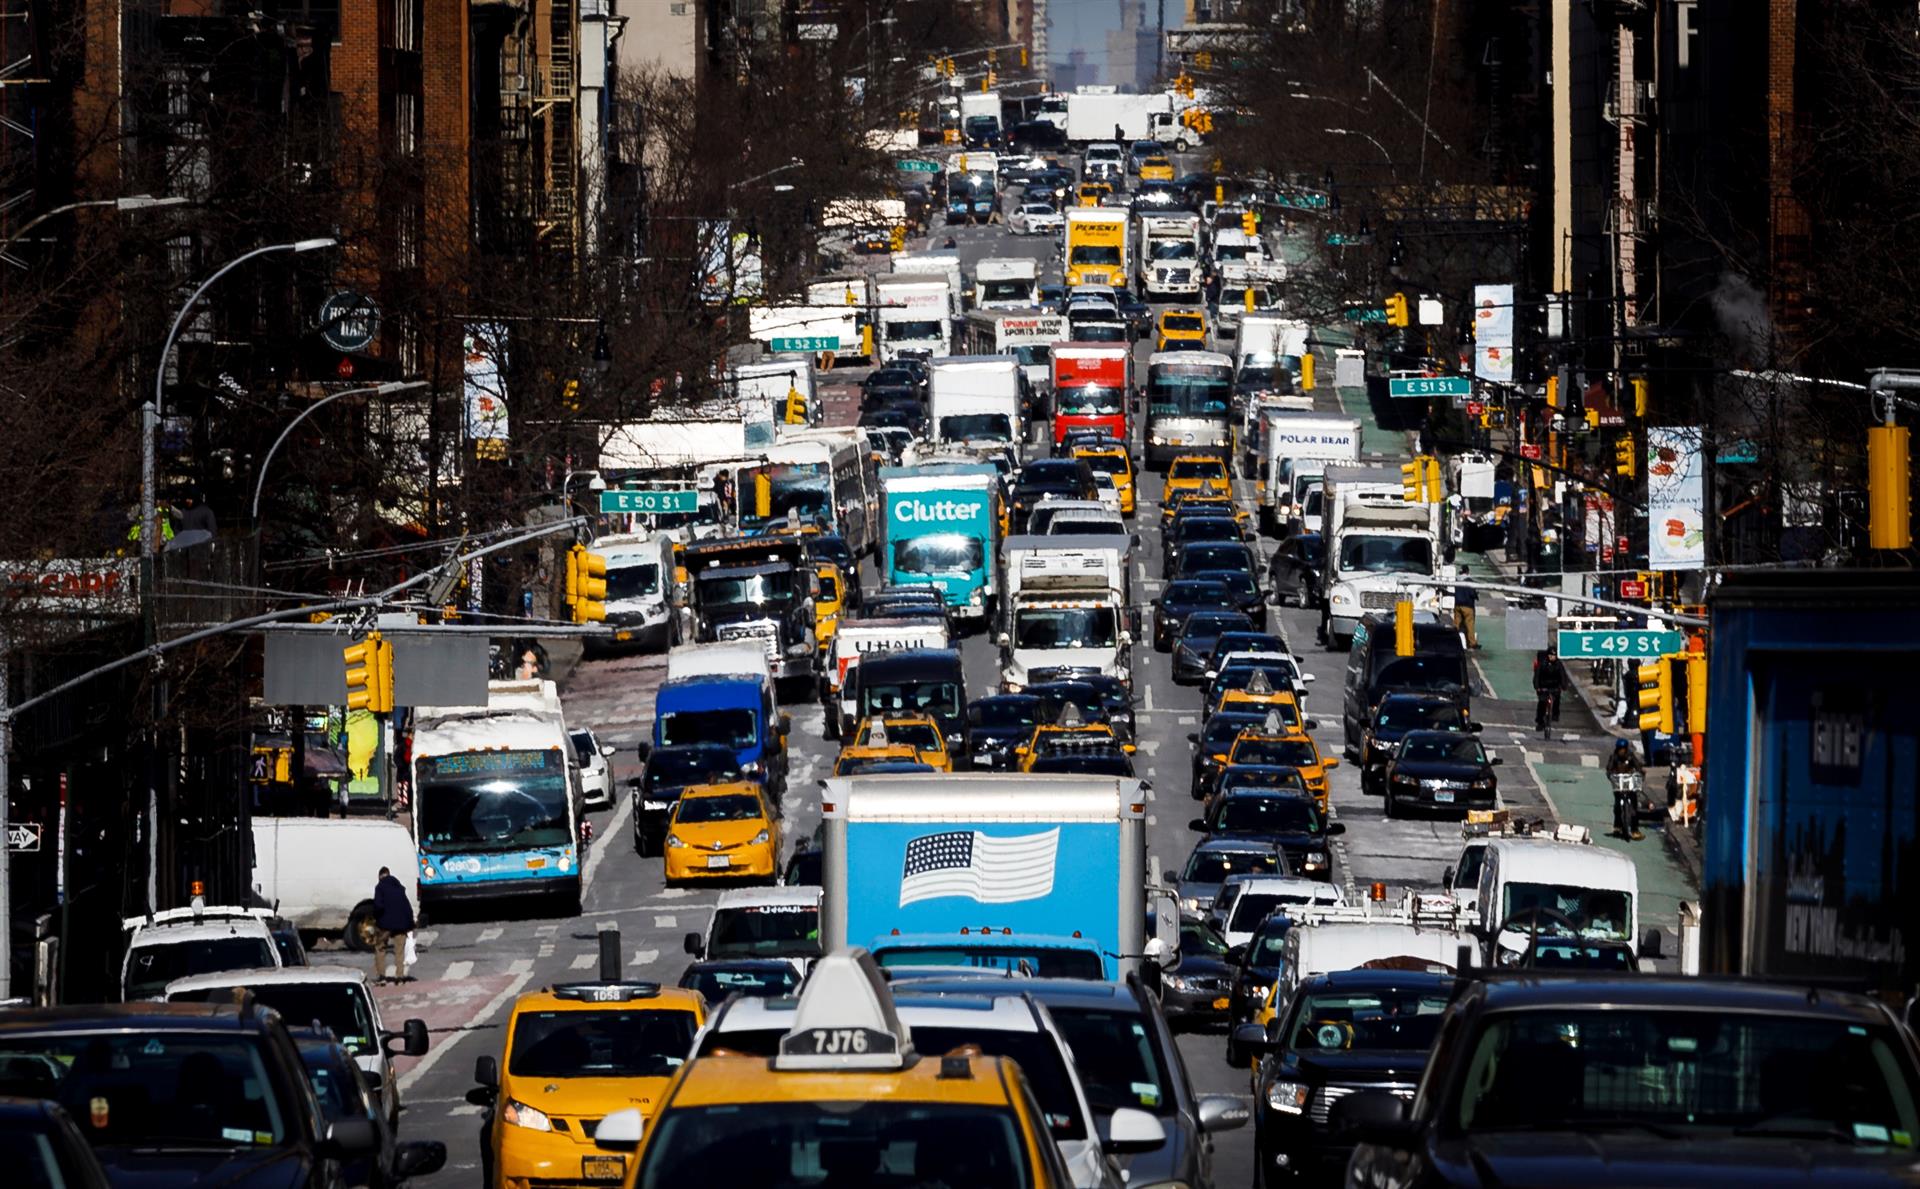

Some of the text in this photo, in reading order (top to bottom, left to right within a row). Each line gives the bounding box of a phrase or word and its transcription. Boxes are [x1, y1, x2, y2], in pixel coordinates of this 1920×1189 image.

[784, 339, 827, 349] E 52 St
[1407, 381, 1453, 392] E 51 St
[1280, 434, 1350, 444] POLAR BEAR
[618, 496, 680, 508] E 50 St
[895, 500, 982, 523] Clutter
[1582, 636, 1660, 651] E 49 St
[813, 1030, 868, 1054] 7J76
